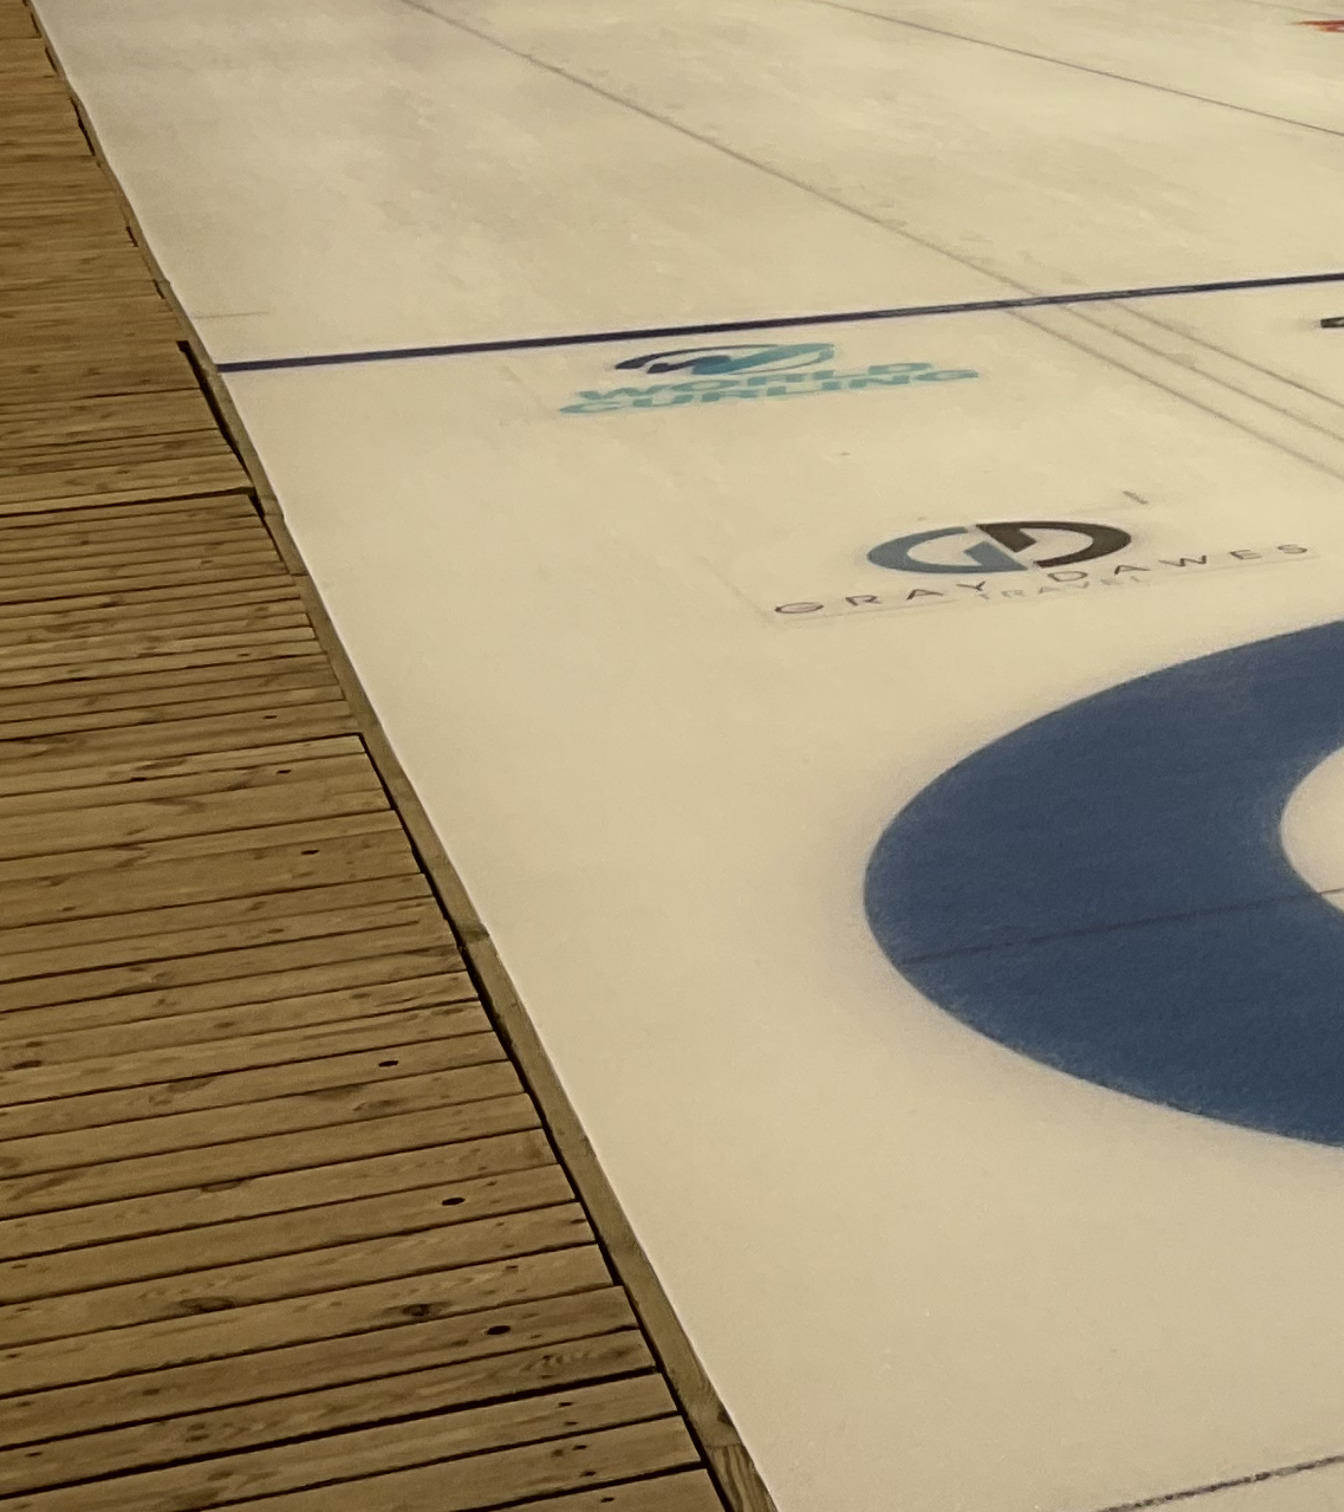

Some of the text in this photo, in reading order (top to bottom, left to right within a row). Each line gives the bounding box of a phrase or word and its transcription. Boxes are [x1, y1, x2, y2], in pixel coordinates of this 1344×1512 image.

[558, 368, 980, 414] CURLING
[574, 362, 934, 400] WORLD
[773, 543, 1310, 616] GRAY DAWES
